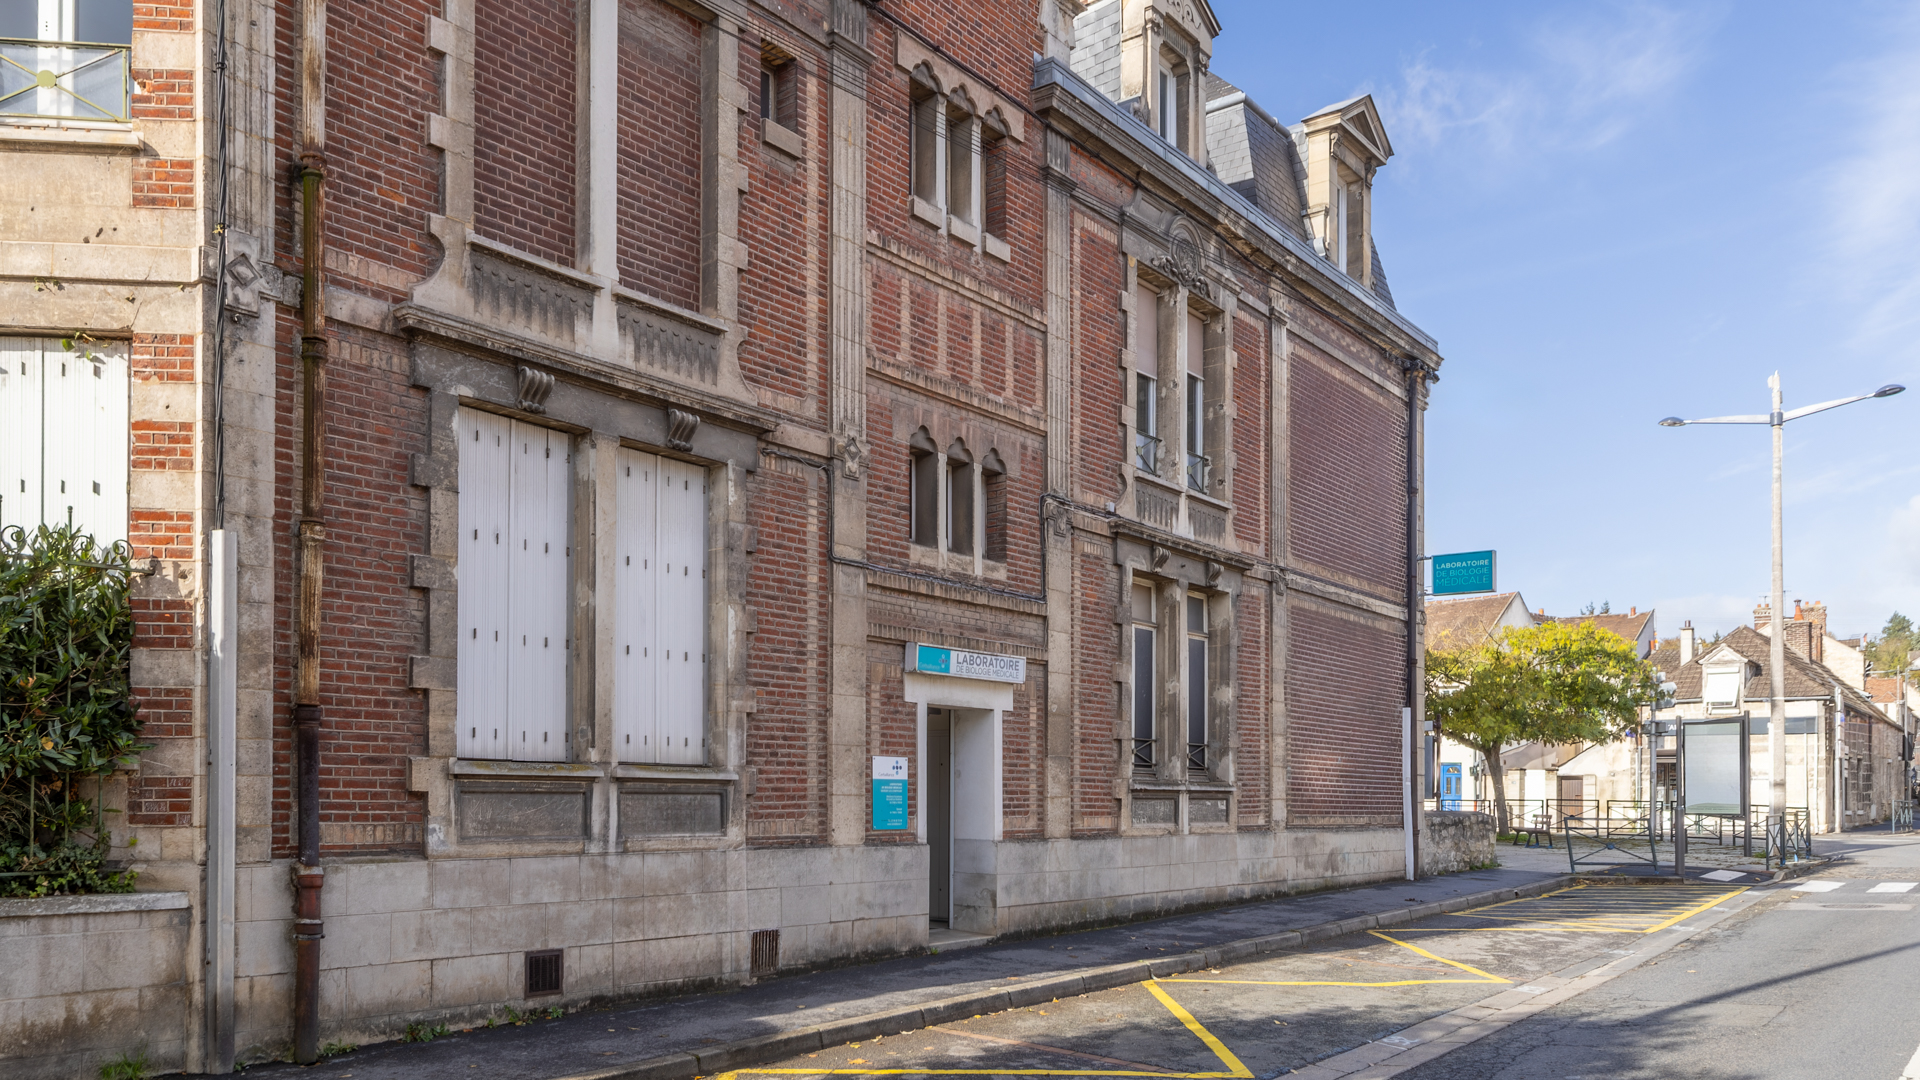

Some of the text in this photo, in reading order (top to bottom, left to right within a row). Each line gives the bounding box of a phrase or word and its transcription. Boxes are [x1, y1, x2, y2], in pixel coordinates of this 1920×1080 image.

[1436, 559, 1489, 569] LABORATOIRE
[1436, 567, 1489, 578] DE BIOLOGIE
[1435, 575, 1489, 586] MÉDICALE
[956, 653, 1020, 671] LABORATOIRE
[956, 665, 964, 673] DE
[965, 667, 992, 676] BIOLOGIE
